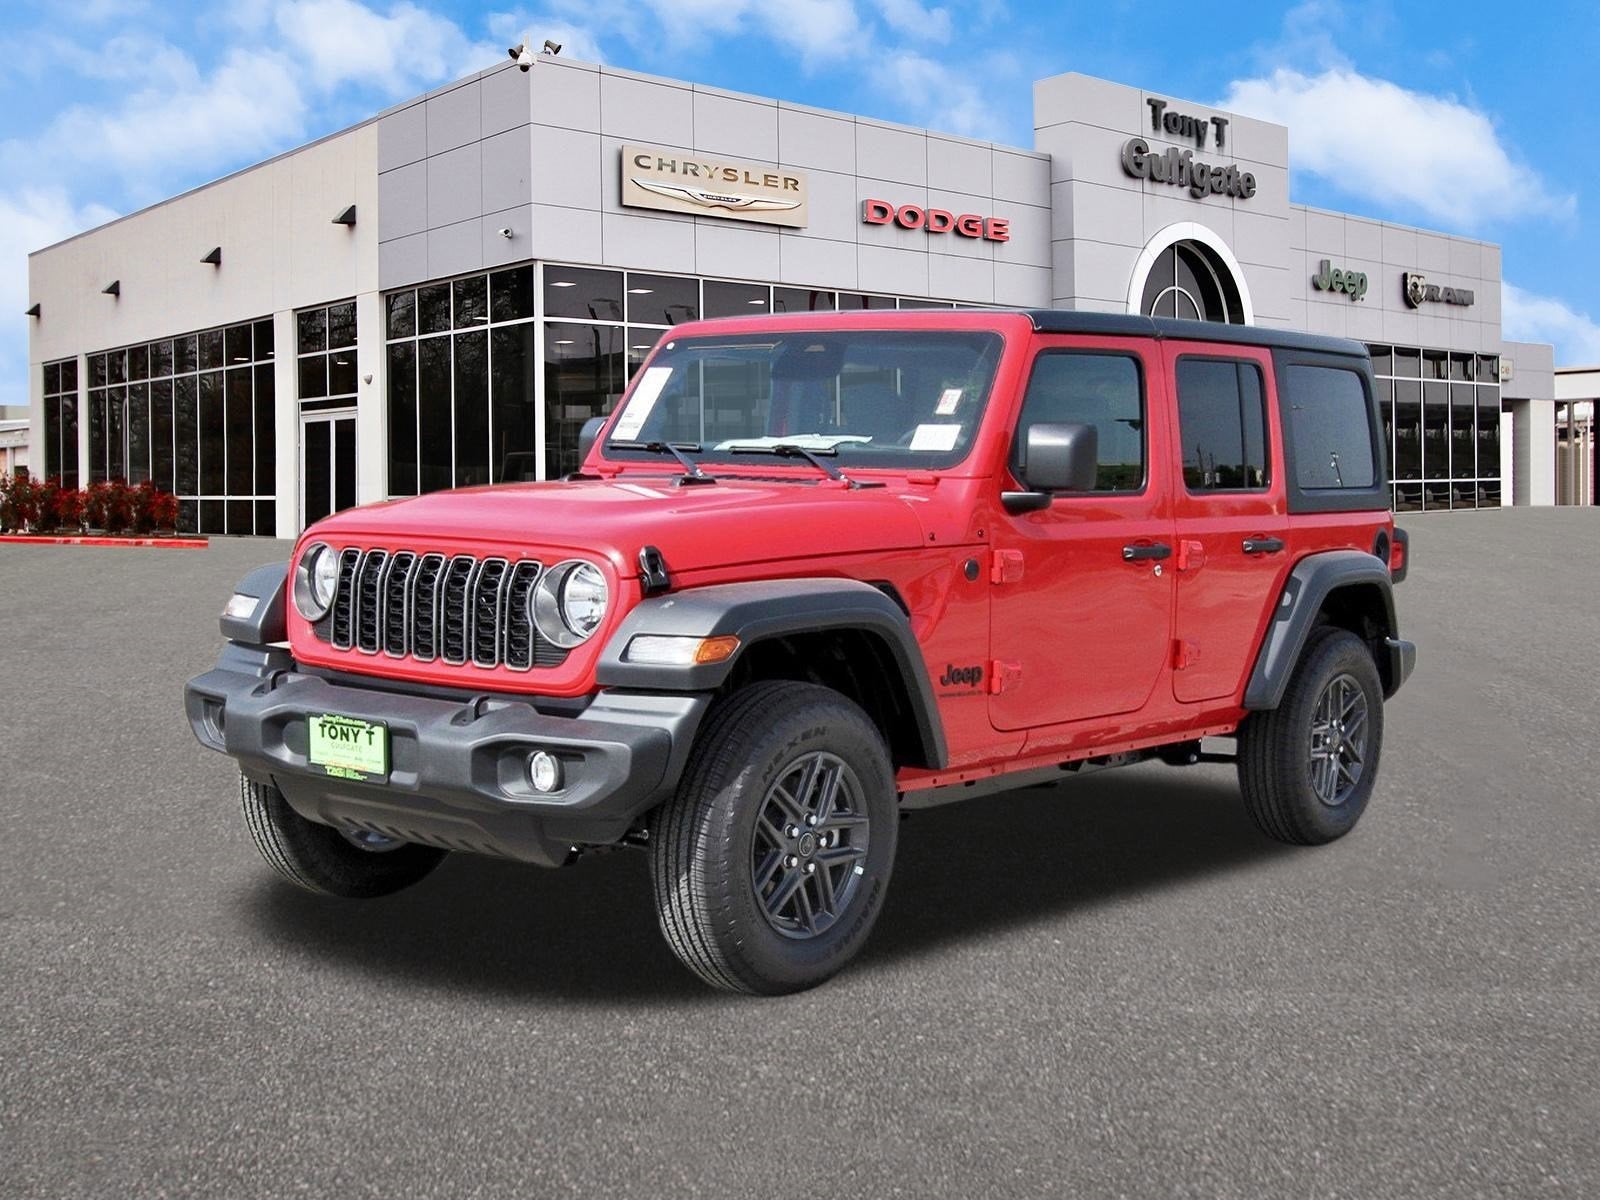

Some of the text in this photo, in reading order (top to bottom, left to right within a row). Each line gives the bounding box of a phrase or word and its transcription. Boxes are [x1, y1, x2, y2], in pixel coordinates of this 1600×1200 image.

[1147, 98, 1229, 147] Tony T
[634, 155, 801, 192] CHRYSLER
[1121, 138, 1256, 199] Gulfgate
[864, 199, 1010, 242] DODGE
[1312, 260, 1368, 302] Jeep
[1426, 284, 1475, 306] RAM
[940, 664, 983, 687] Jeep
[319, 723, 375, 745] TONY T
